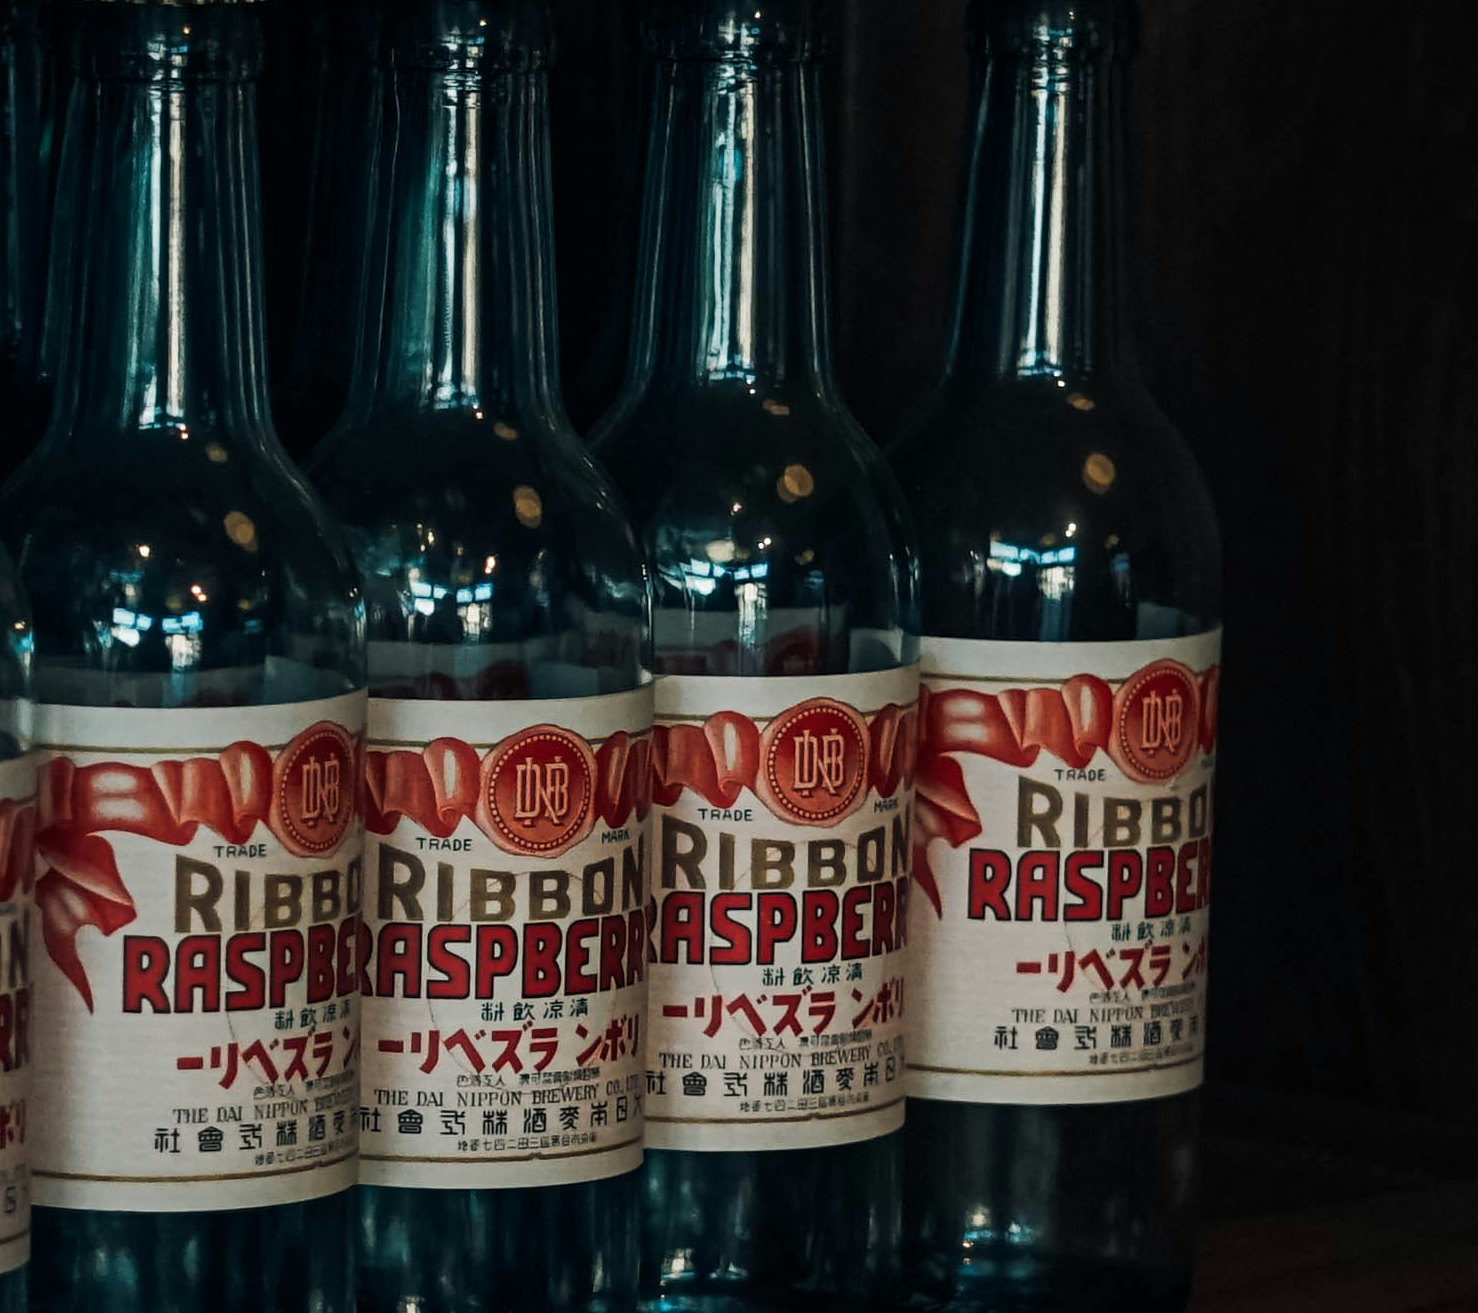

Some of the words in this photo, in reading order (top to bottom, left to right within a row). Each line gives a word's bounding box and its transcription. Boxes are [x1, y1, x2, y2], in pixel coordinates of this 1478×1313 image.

[1055, 768, 1106, 782] TRADE
[698, 808, 753, 822] TRADE
[874, 798, 898, 813] MARK
[214, 844, 266, 858] TRADE
[416, 837, 472, 851] TRADE
[601, 830, 629, 844] MARK
[661, 802, 910, 890] RIBBON
[378, 833, 644, 922] RIBBON
[175, 854, 362, 933] RIBBO
[1012, 1008, 1045, 1024] THE
[1053, 1008, 1078, 1024] DAI
[1090, 1006, 1143, 1023] NIPPON
[659, 1052, 693, 1069] THE
[701, 1053, 726, 1070] DAI
[740, 1053, 802, 1070] NIPPON
[811, 1043, 872, 1066] BREWERY
[374, 1089, 408, 1106] THE
[417, 1089, 444, 1107] DAI
[457, 1090, 522, 1107] NIPPON
[532, 1083, 600, 1106] BREWERY
[173, 1107, 208, 1124] THE
[217, 1106, 243, 1123] DAI
[254, 1099, 308, 1120] NIPPON
